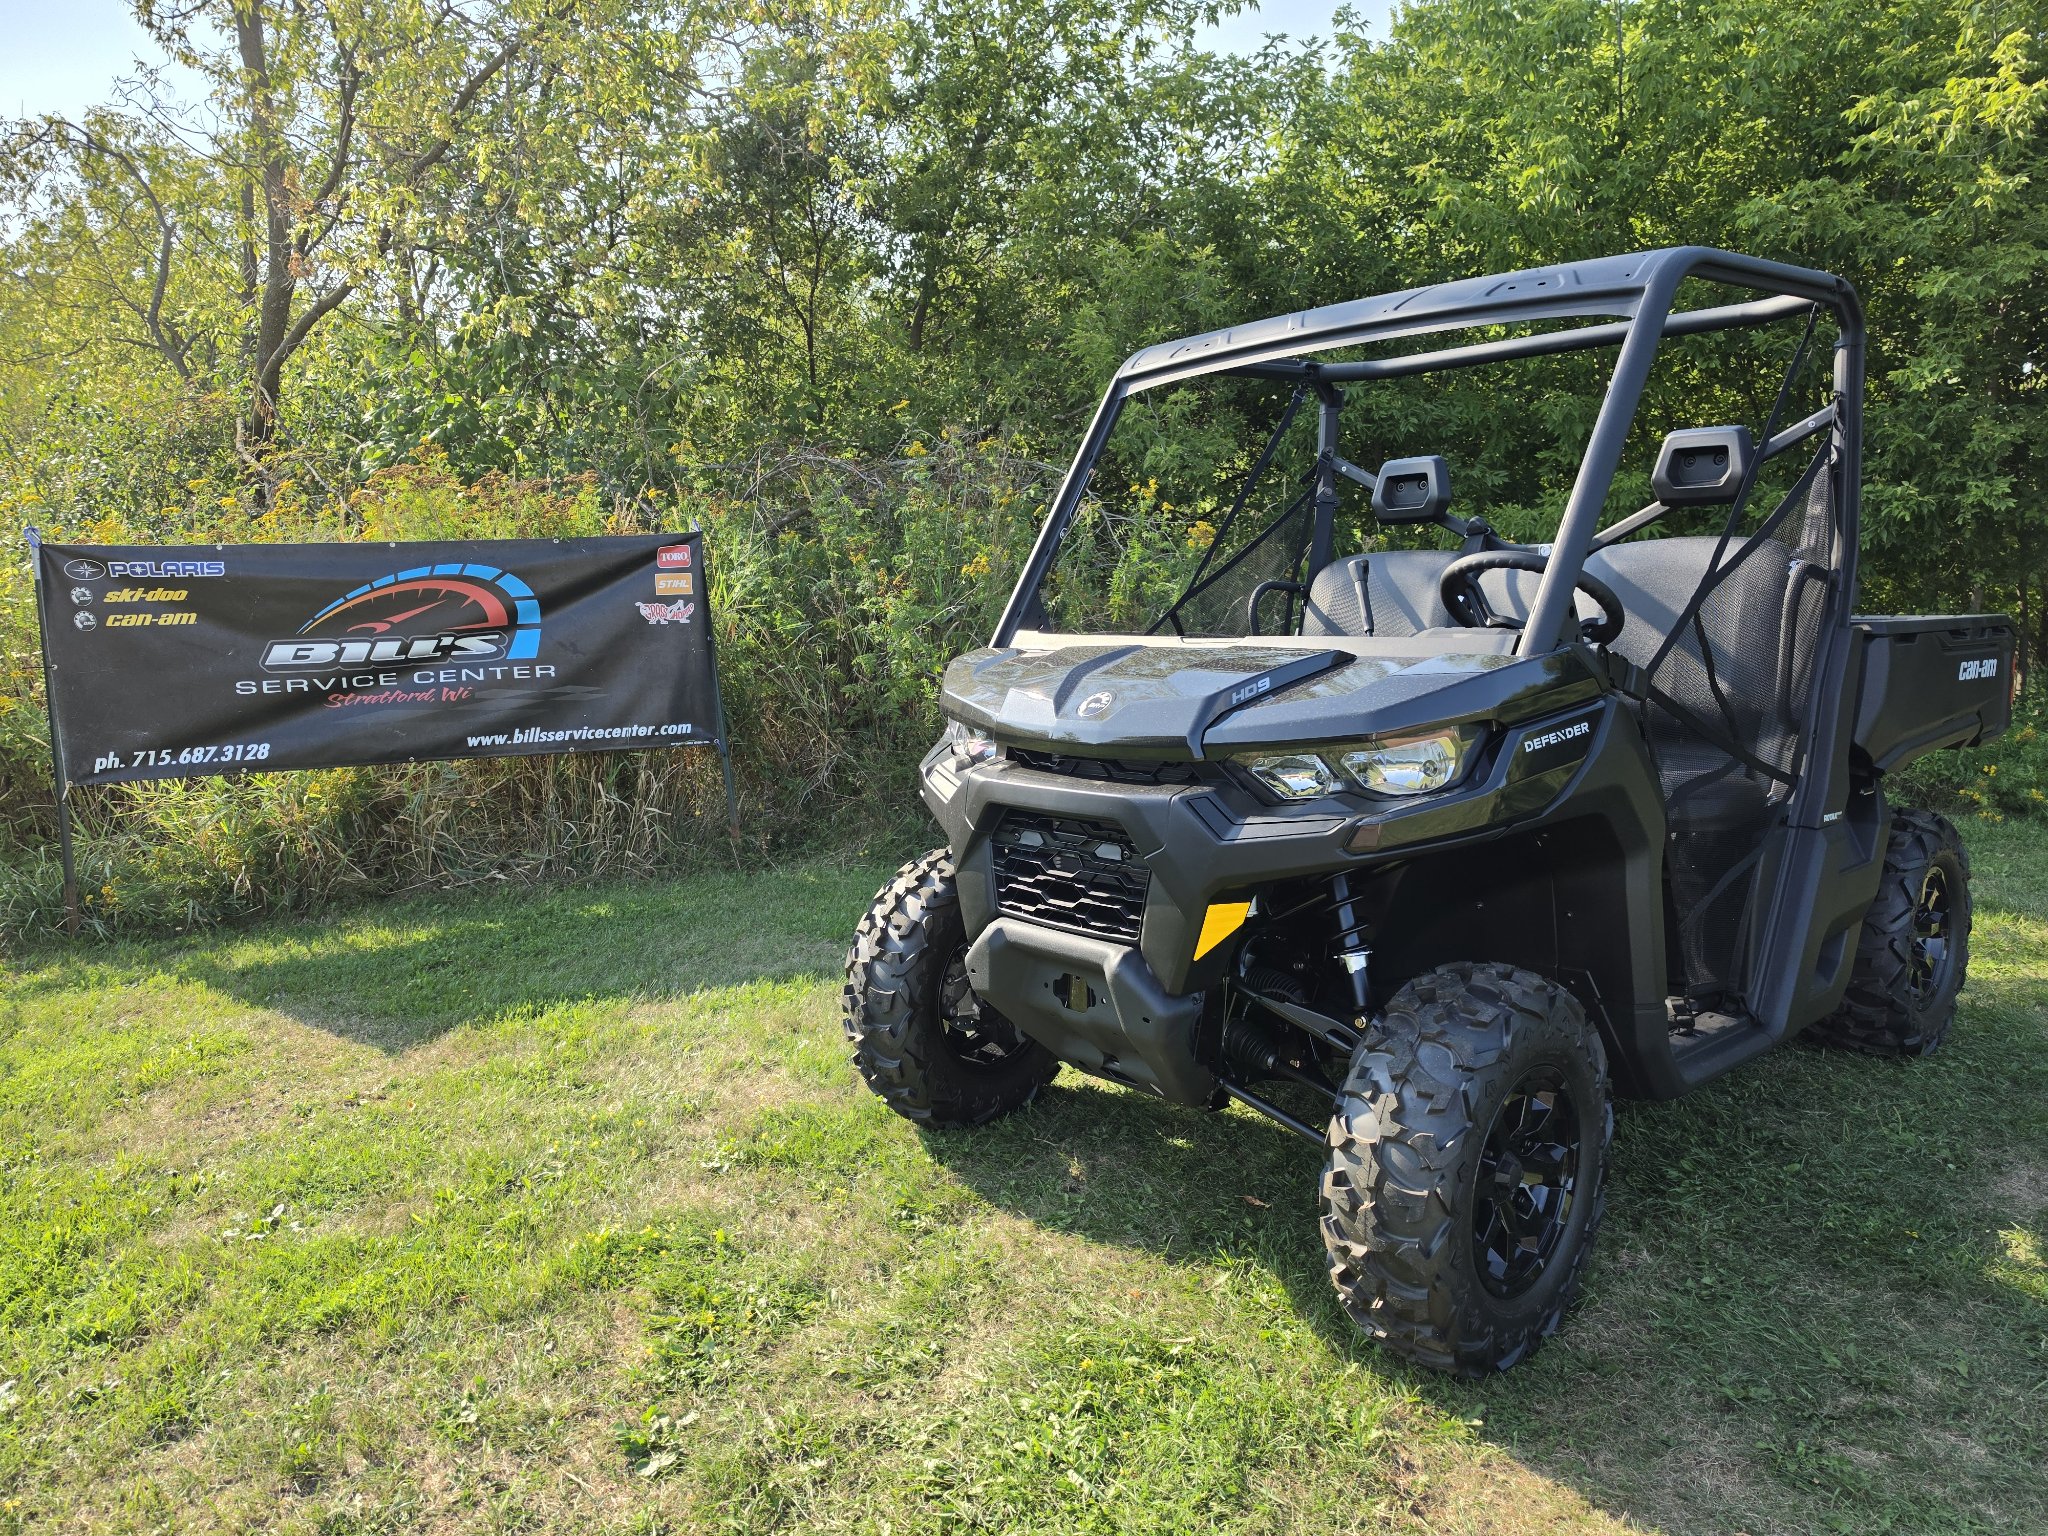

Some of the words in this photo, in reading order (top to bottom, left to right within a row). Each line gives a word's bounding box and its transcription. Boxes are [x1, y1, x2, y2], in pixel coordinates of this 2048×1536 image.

[661, 552, 688, 561] TORO
[108, 561, 225, 578] POLARIS
[103, 587, 188, 602] ski-doo
[659, 580, 689, 588] STIHL
[105, 612, 197, 627] can-am
[265, 635, 499, 665] BILL'S
[235, 673, 397, 695] SERVICE
[413, 665, 556, 684] CENTER
[1959, 658, 1998, 681] can-am
[323, 687, 436, 708] Stratford,
[441, 686, 474, 702] Wi
[1232, 676, 1270, 705] HD9
[467, 723, 692, 747] www.billsservicecenter.com
[1524, 722, 1590, 753] DEFENDER
[94, 751, 125, 774] ph.
[132, 743, 270, 767] 715.687.3128
